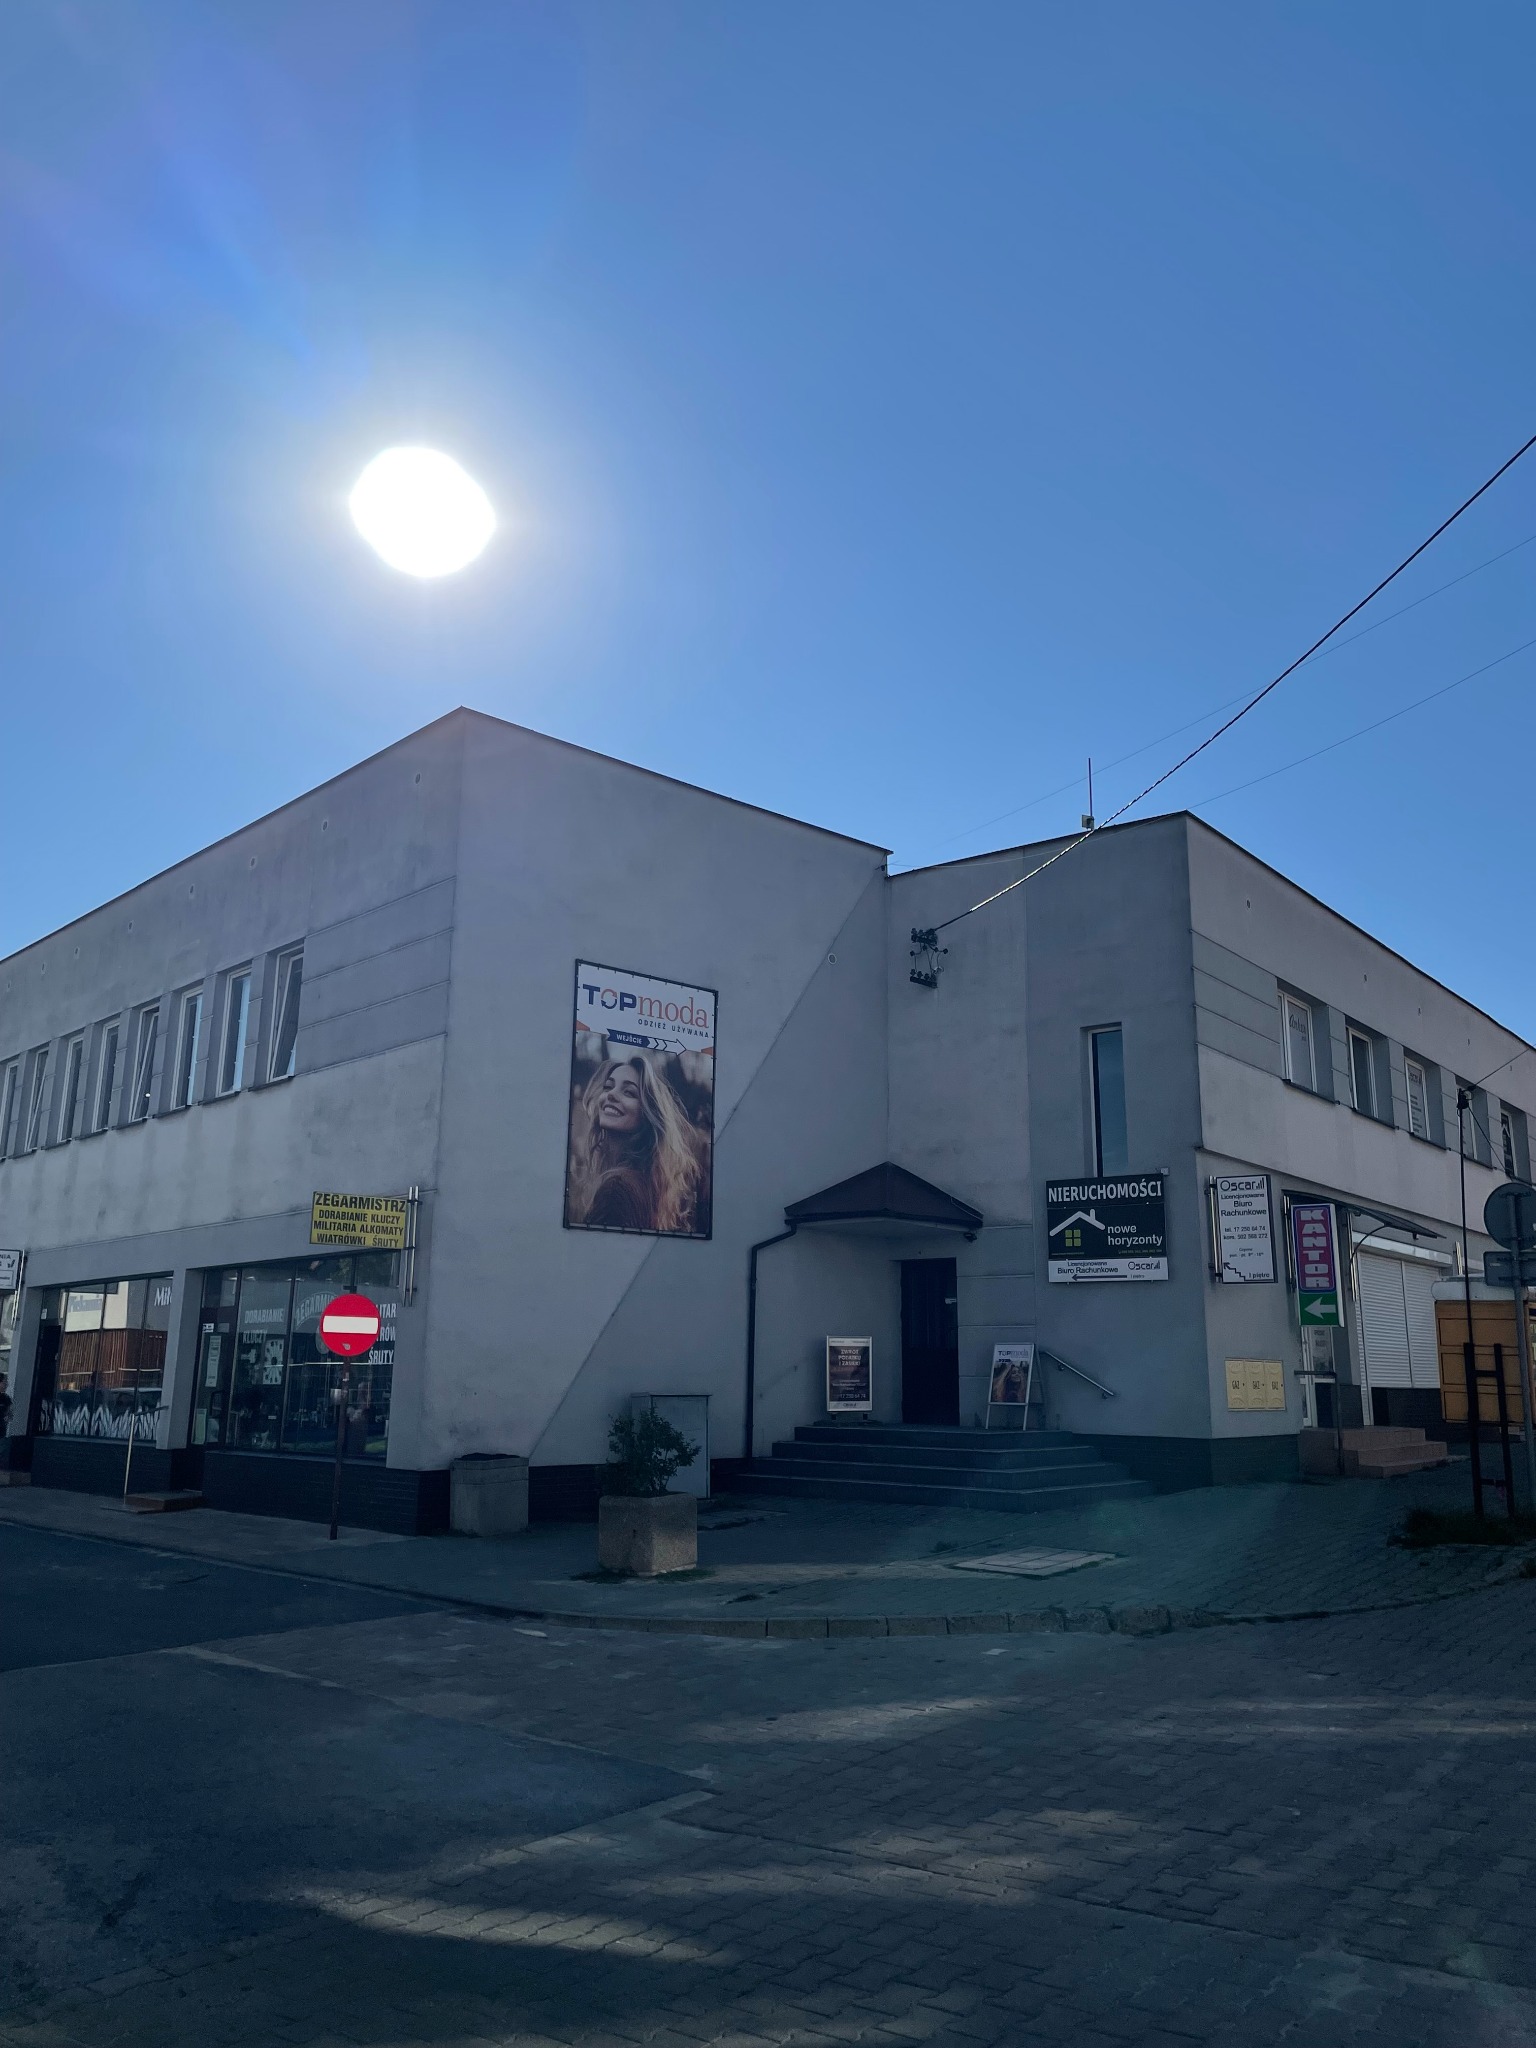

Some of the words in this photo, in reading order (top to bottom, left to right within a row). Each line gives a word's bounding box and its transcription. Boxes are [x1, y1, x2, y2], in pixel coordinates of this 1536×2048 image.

[638, 1018, 666, 1030] ODZIEŻ
[671, 1025, 709, 1039] UŻYWANA
[616, 1033, 643, 1045] WEJŚCIE
[1048, 1178, 1162, 1203] NIERUCHOMOŚCI
[1220, 1180, 1256, 1192] Oscar
[315, 1193, 406, 1213] ZEGARMISTRZ
[1234, 1200, 1253, 1208] Biuro
[318, 1209, 368, 1222] DORABIANIE
[371, 1214, 401, 1225] KLUCZY
[1221, 1209, 1267, 1217] Rachunkowe
[314, 1220, 357, 1233] MILITARIA
[360, 1224, 404, 1236] ALKOMATY
[1107, 1225, 1137, 1234] nowe
[317, 1233, 366, 1245] WIATRÓWKI
[372, 1235, 399, 1248] ŚRUTY
[1107, 1234, 1163, 1247] horyzonty
[1299, 1209, 1330, 1288] KANTOR
[245, 1308, 284, 1323] DORABIANIE
[368, 1347, 394, 1364] ŚRUTY
